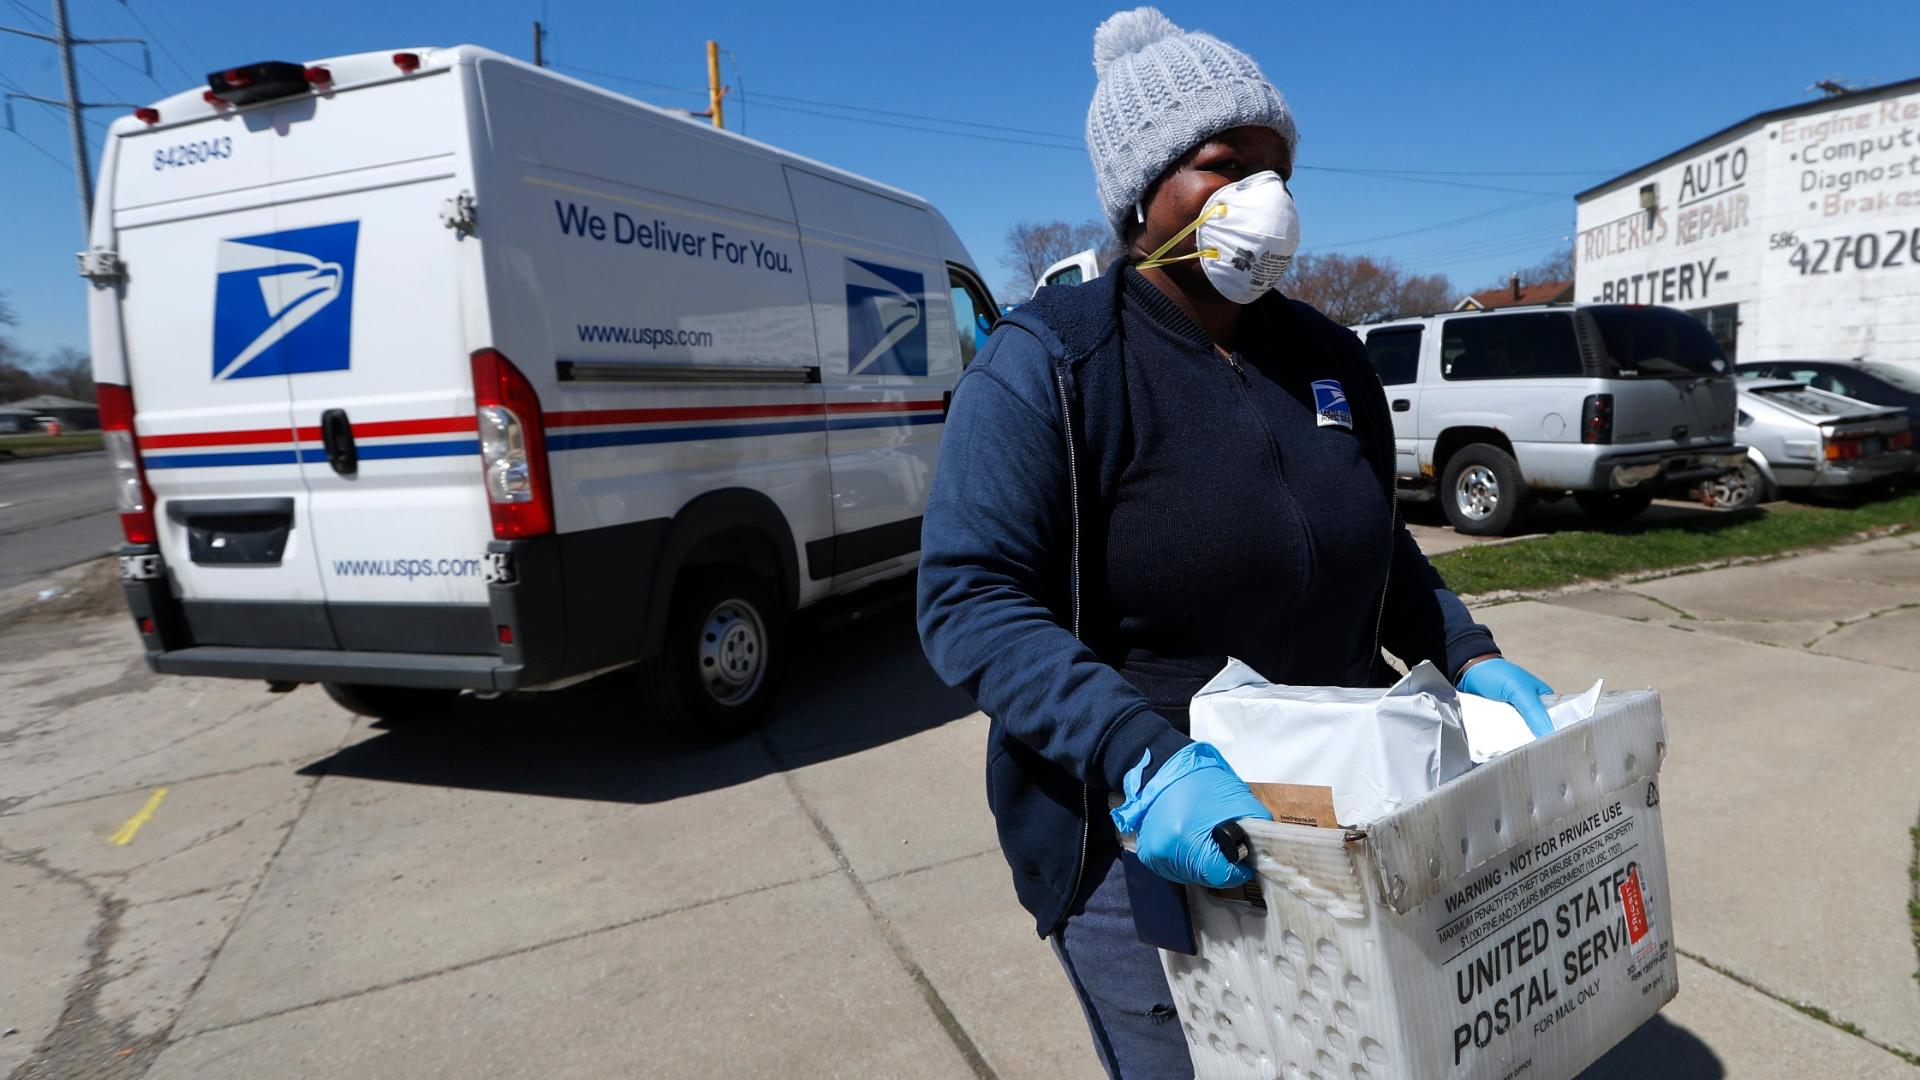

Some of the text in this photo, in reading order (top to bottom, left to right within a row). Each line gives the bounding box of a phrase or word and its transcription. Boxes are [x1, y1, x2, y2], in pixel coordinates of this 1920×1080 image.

[154, 137, 232, 171] 8426043
[1781, 113, 1871, 144] Engine
[1802, 127, 1920, 163] Comput
[1679, 147, 1748, 202] AUTO
[554, 199, 793, 274] We Deliver For You.
[1676, 194, 1750, 246] REPAIR
[577, 324, 713, 349] www.usps.com
[1439, 820, 1635, 945] MAXIMUM PENALTY FOR THEFT OR MISUSE OF POSTAL PROPERTY
[1444, 868, 1501, 913] WARNING
[1510, 849, 1532, 876] NOT
[1534, 837, 1558, 861] FOR
[1559, 812, 1601, 848] PRIVATE
[1602, 802, 1623, 823] USE
[1482, 919, 1499, 934] FINE
[1498, 907, 1515, 925] AND
[1518, 890, 1540, 913] YEARS
[1539, 863, 1586, 897] IMPRISONMENT
[1594, 849, 1609, 865] USC
[1625, 882, 1639, 933] PRIORIT
[1457, 918, 1549, 1005] UNITED
[1454, 967, 1557, 1066] POSTAL
[1564, 915, 1628, 986] SERVI
[1534, 978, 1601, 1038] FOR MAIL ONLY
